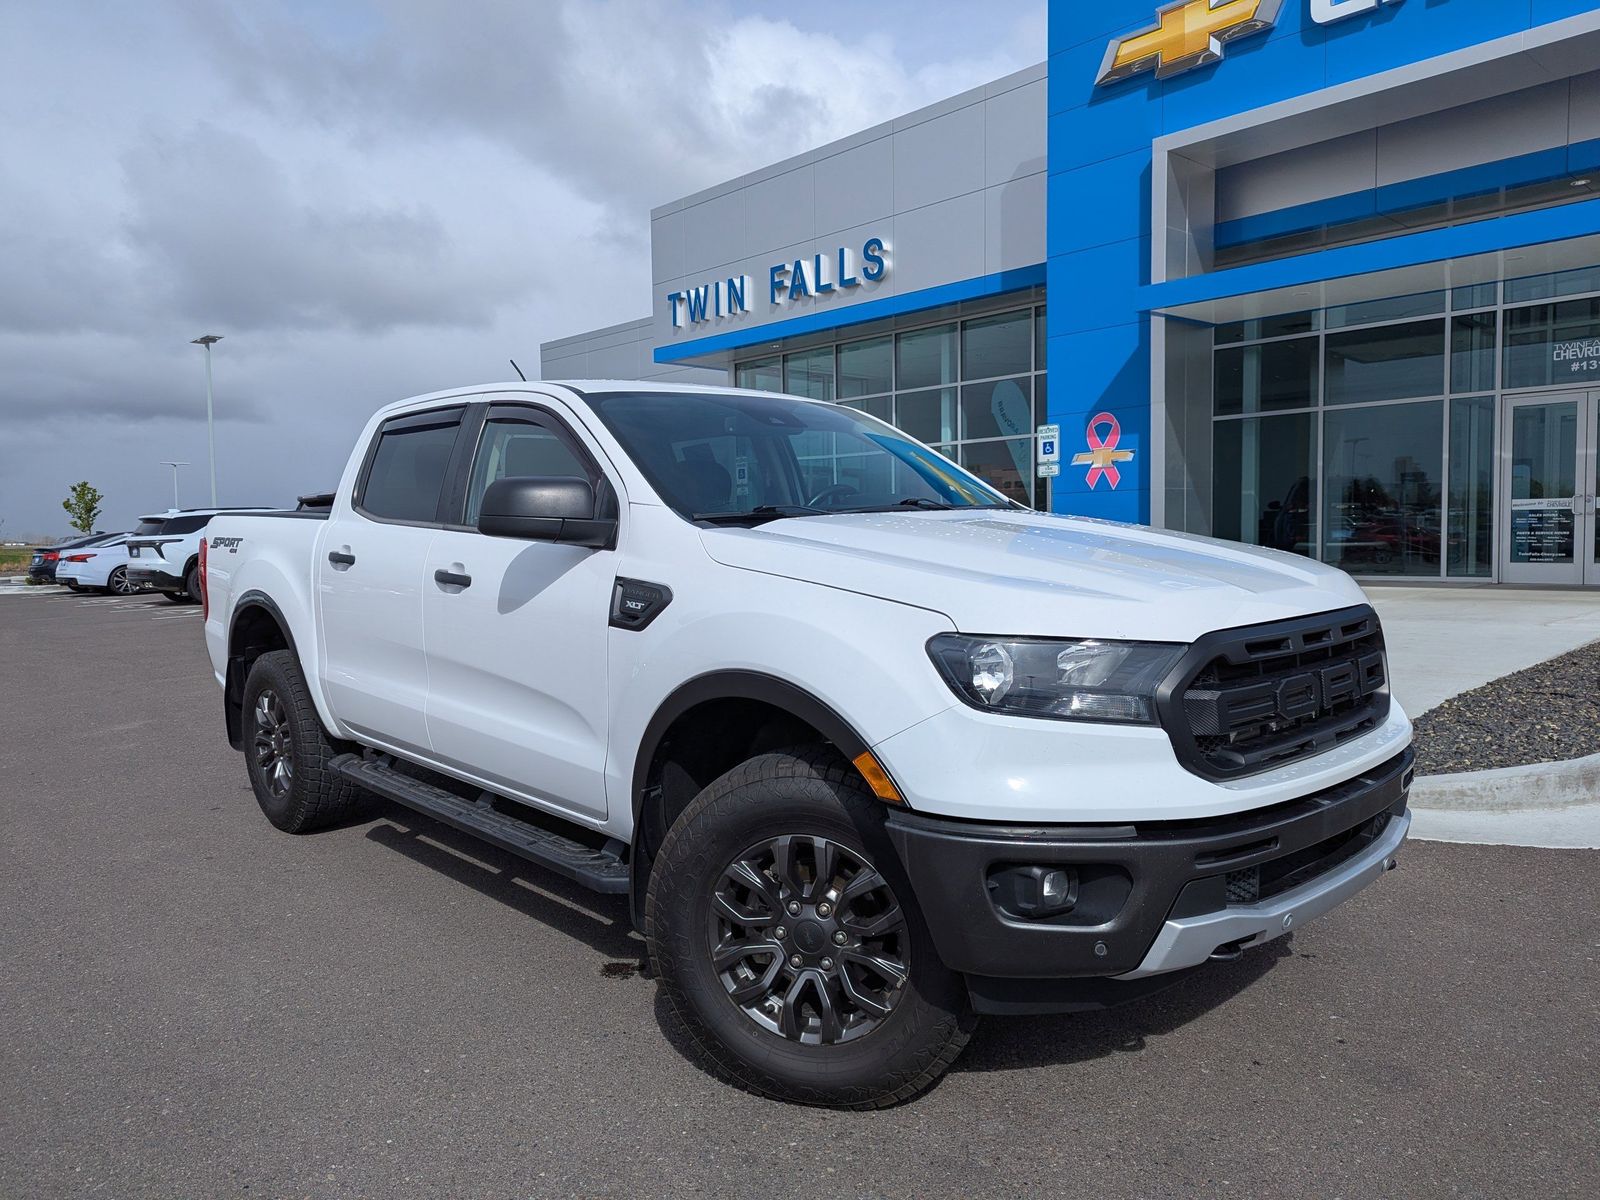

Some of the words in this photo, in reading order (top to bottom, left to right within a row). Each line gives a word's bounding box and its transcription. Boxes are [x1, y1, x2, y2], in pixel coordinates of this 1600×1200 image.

[668, 275, 751, 328] TWIN
[769, 238, 889, 304] FALLS
[1553, 345, 1600, 361] CHEVRO
[1571, 360, 1600, 372] #13
[210, 537, 243, 549] SPORT
[625, 600, 645, 610] XLT
[1220, 650, 1386, 735] FORD
